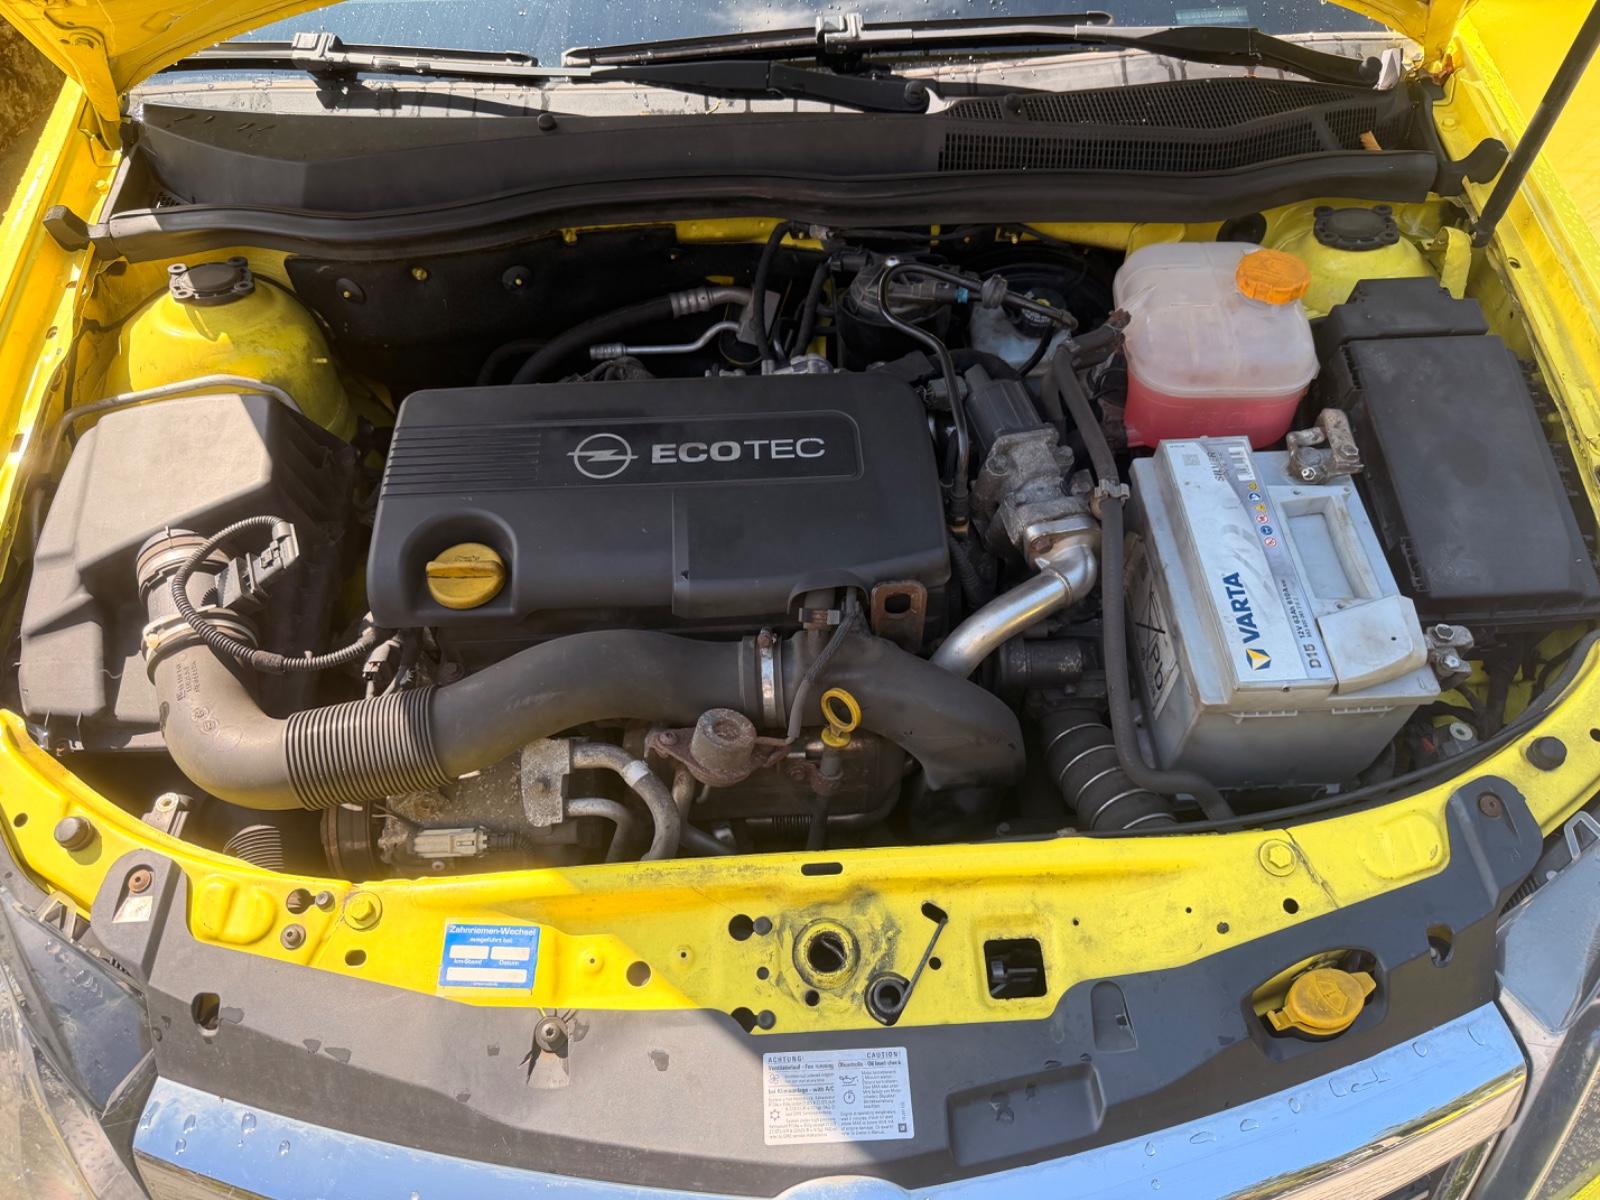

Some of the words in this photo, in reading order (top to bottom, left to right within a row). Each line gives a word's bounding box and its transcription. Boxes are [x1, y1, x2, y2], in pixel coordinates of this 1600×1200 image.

[651, 438, 826, 464] ECOTEC
[1222, 571, 1261, 645] VARTA
[1303, 643, 1322, 669] D15
[448, 925, 537, 936] Zahnriemen-Wechsel
